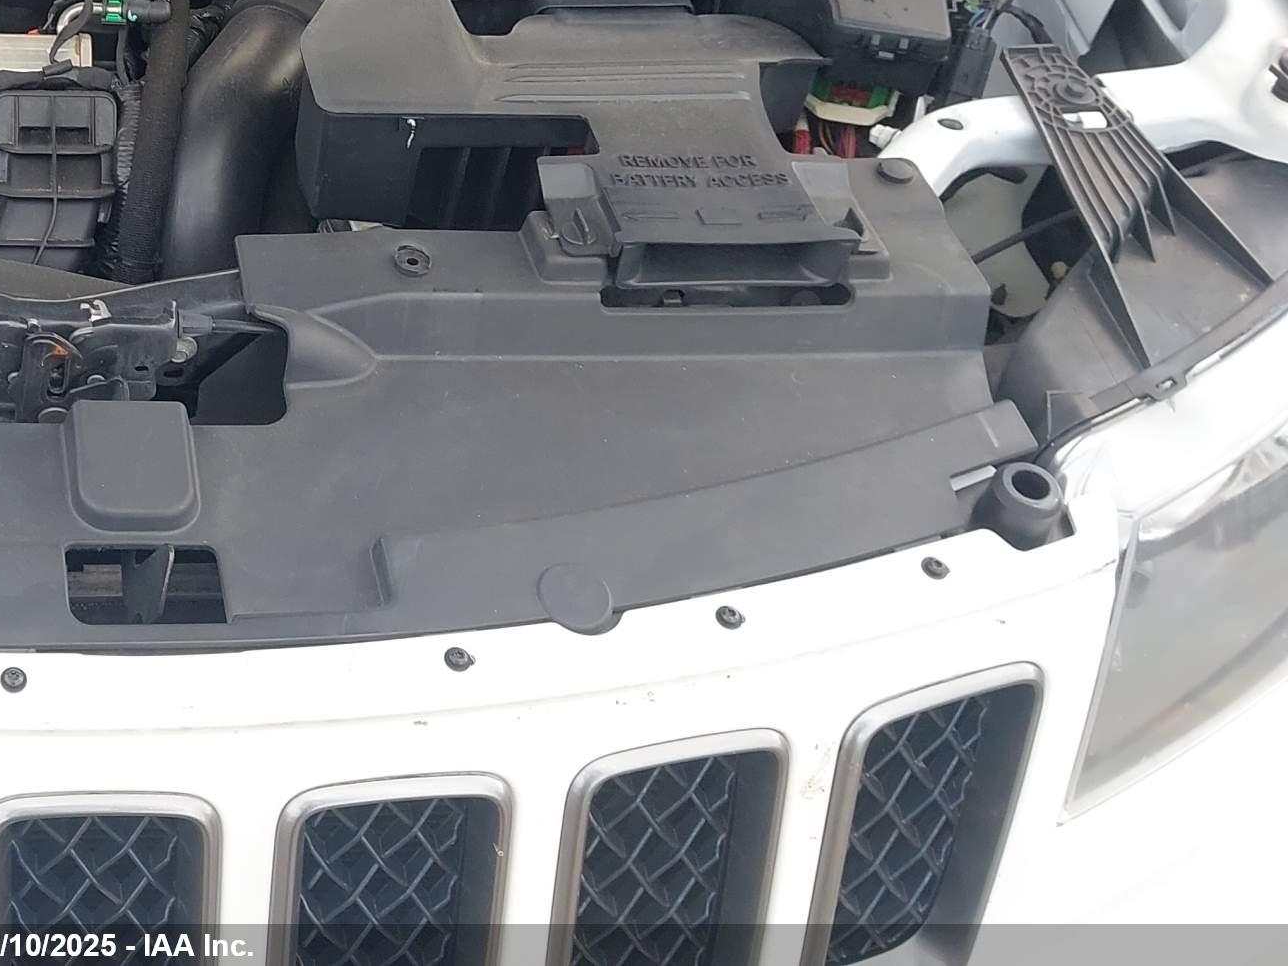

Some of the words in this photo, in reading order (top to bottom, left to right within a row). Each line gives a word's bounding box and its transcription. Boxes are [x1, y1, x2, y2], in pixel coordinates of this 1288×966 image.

[620, 154, 711, 169] REMOVE
[713, 154, 757, 168] FOR
[612, 173, 698, 188] BATTERY
[708, 172, 789, 187] ACCESS
